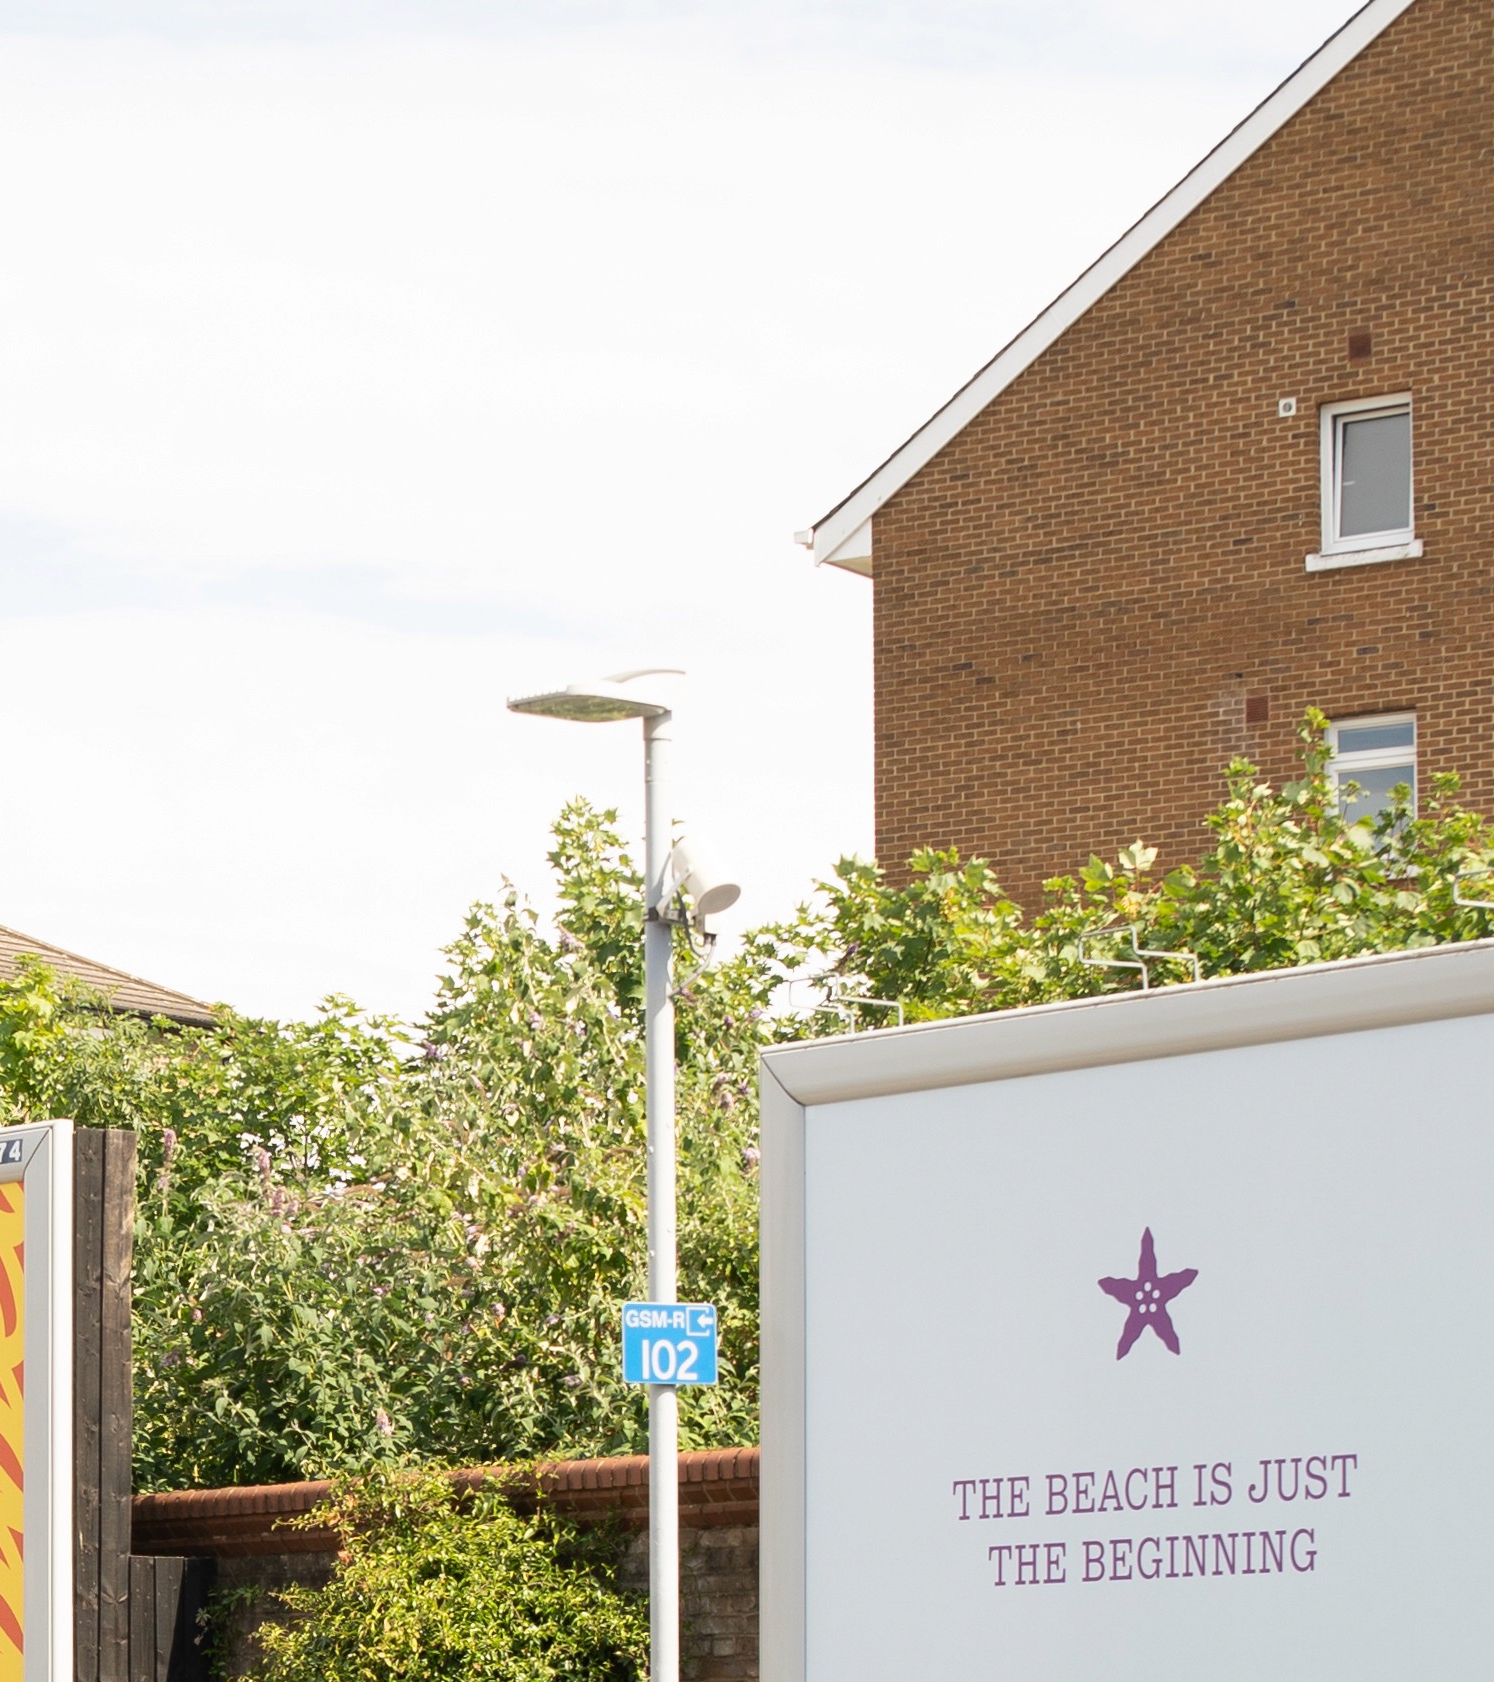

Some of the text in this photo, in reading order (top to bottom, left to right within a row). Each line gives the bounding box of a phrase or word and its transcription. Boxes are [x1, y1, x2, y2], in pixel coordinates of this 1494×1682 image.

[625, 1309, 686, 1328] GSM-R
[641, 1338, 698, 1380] 102
[952, 1454, 1359, 1521] THE BEACH IS JUST
[987, 1528, 1318, 1587] THE BEGINNING
